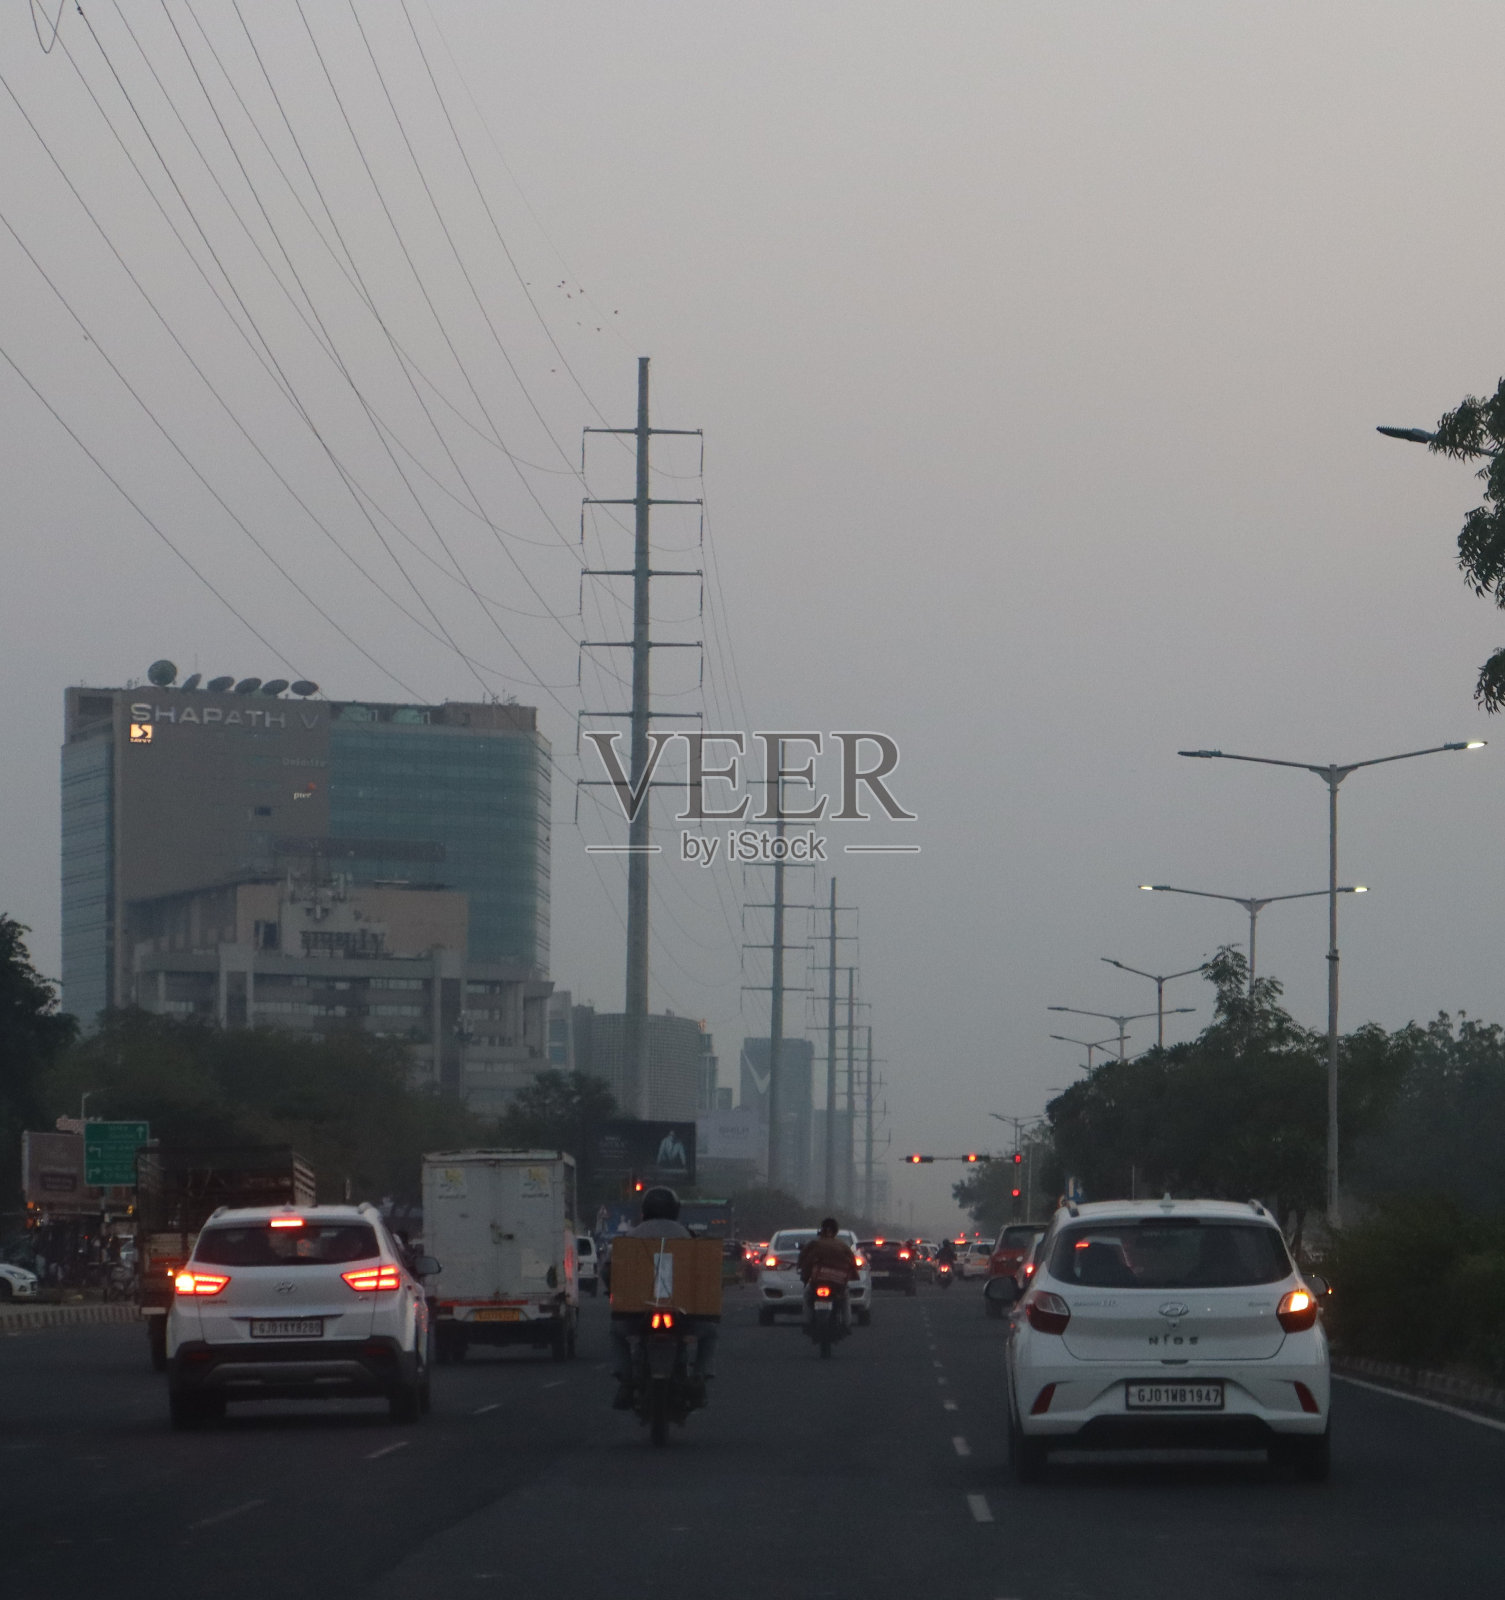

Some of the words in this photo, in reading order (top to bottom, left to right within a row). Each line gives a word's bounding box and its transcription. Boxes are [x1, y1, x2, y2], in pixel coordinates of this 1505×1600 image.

[130, 702, 286, 728] SHAPATH
[299, 712, 320, 729] V
[1137, 1388, 1220, 1403] GJ01WB1947
